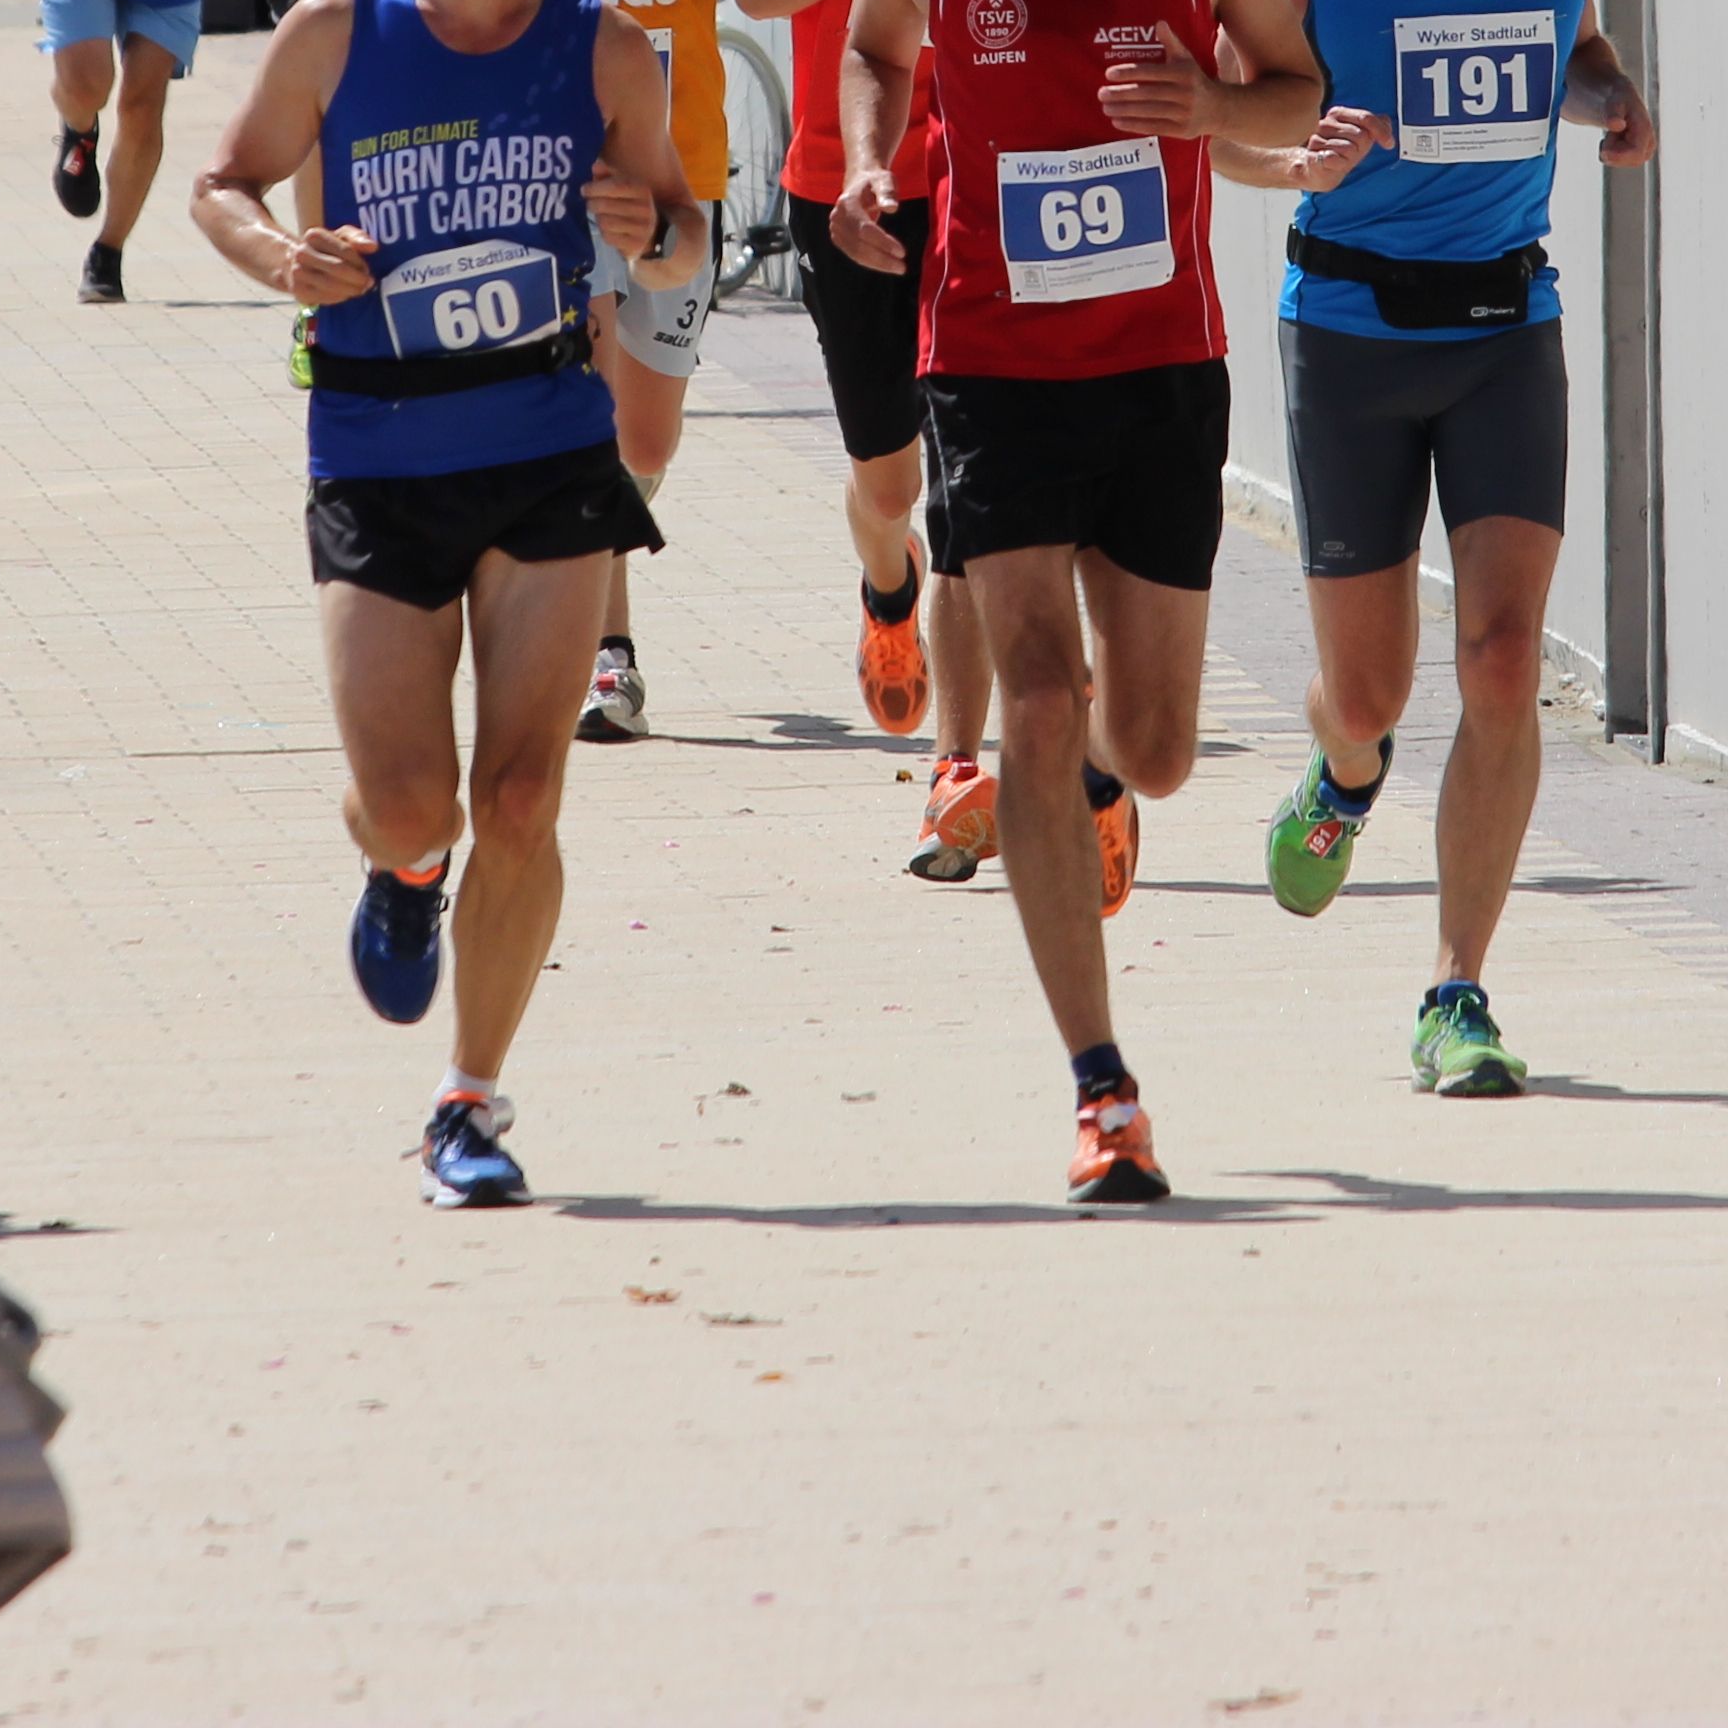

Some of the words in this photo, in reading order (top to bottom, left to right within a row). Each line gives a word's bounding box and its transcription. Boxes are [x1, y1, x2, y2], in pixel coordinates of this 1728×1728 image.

[977, 10, 1015, 25] TSVE
[985, 27, 1009, 37] 1890
[1417, 28, 1465, 46] Wyker
[1470, 24, 1538, 42] Stadtlauf
[973, 50, 1026, 65] LAUFEN
[1104, 51, 1163, 60] SPORTSHOP
[1422, 53, 1528, 117] 191
[351, 136, 377, 160] RUN
[381, 128, 409, 152] FOR
[413, 119, 479, 143] CLIMATE
[352, 143, 445, 204] BURN
[455, 135, 573, 185] CARBS
[1017, 161, 1065, 179] Wyker
[1068, 149, 1141, 174] Stadtlauf
[358, 194, 420, 245] NOT
[428, 182, 569, 234] CARBON
[1040, 184, 1124, 252] 69
[401, 264, 452, 284] Wyker
[433, 279, 520, 350] 60
[676, 299, 698, 330] 3
[1308, 827, 1332, 855] 191
